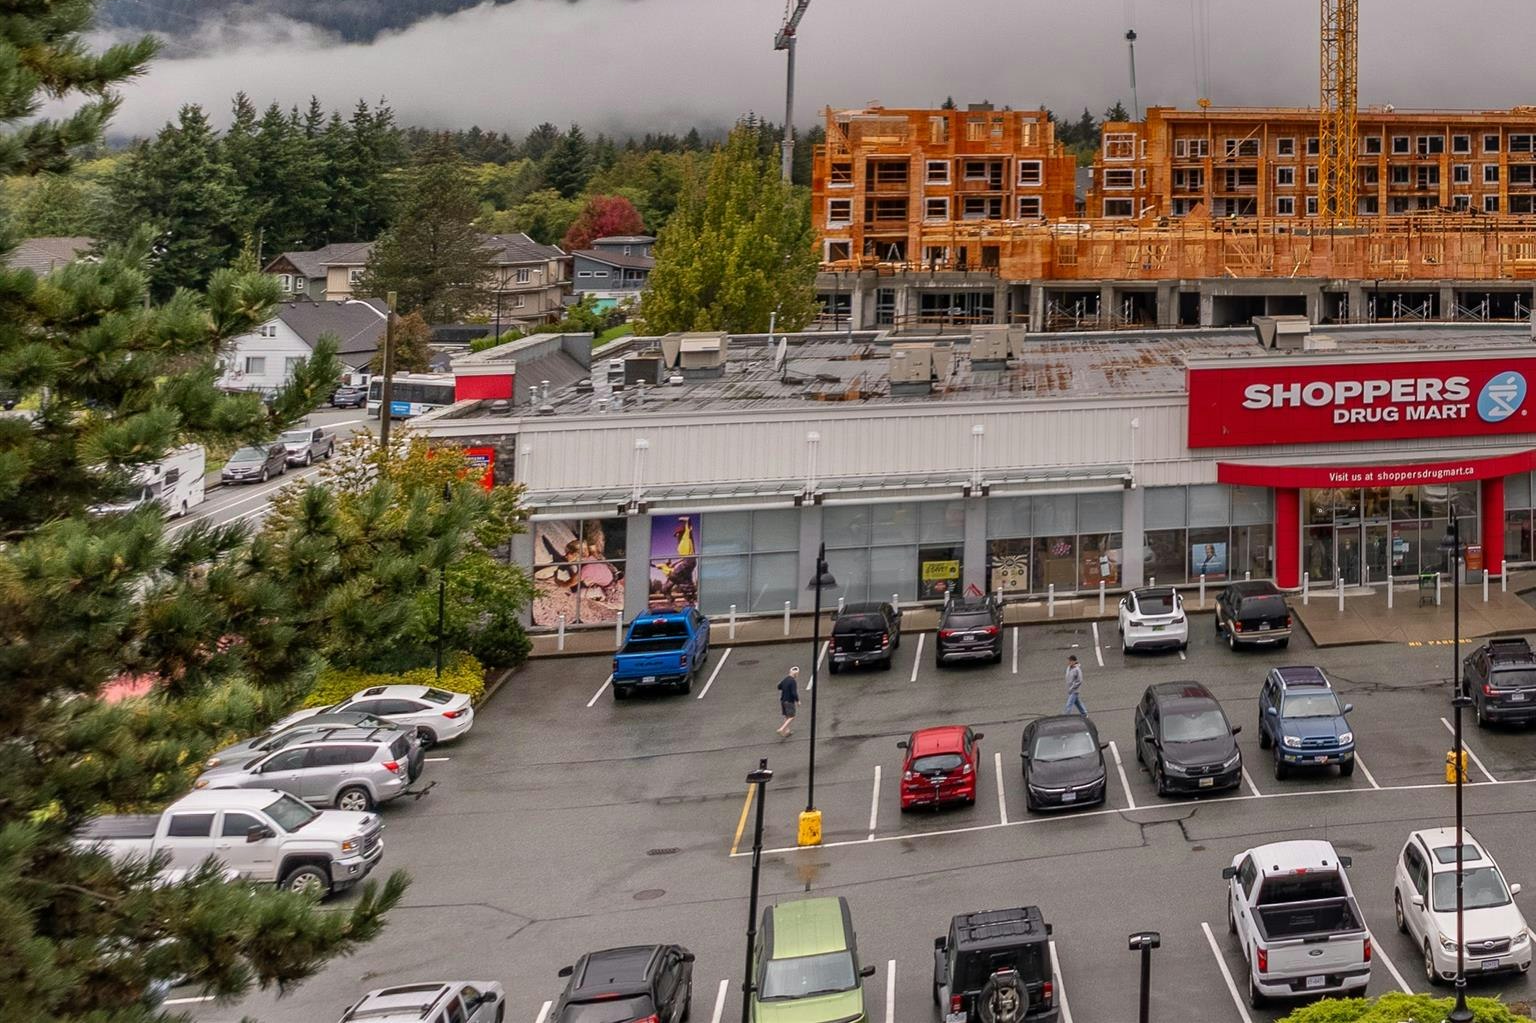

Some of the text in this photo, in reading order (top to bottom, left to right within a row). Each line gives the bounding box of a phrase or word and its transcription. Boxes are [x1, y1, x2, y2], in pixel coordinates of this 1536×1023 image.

[1242, 376, 1471, 409] SHOPPERS
[1333, 404, 1471, 424] DRUG MART
[1329, 467, 1474, 482] Visit us at shoppersdrugmart.ca
